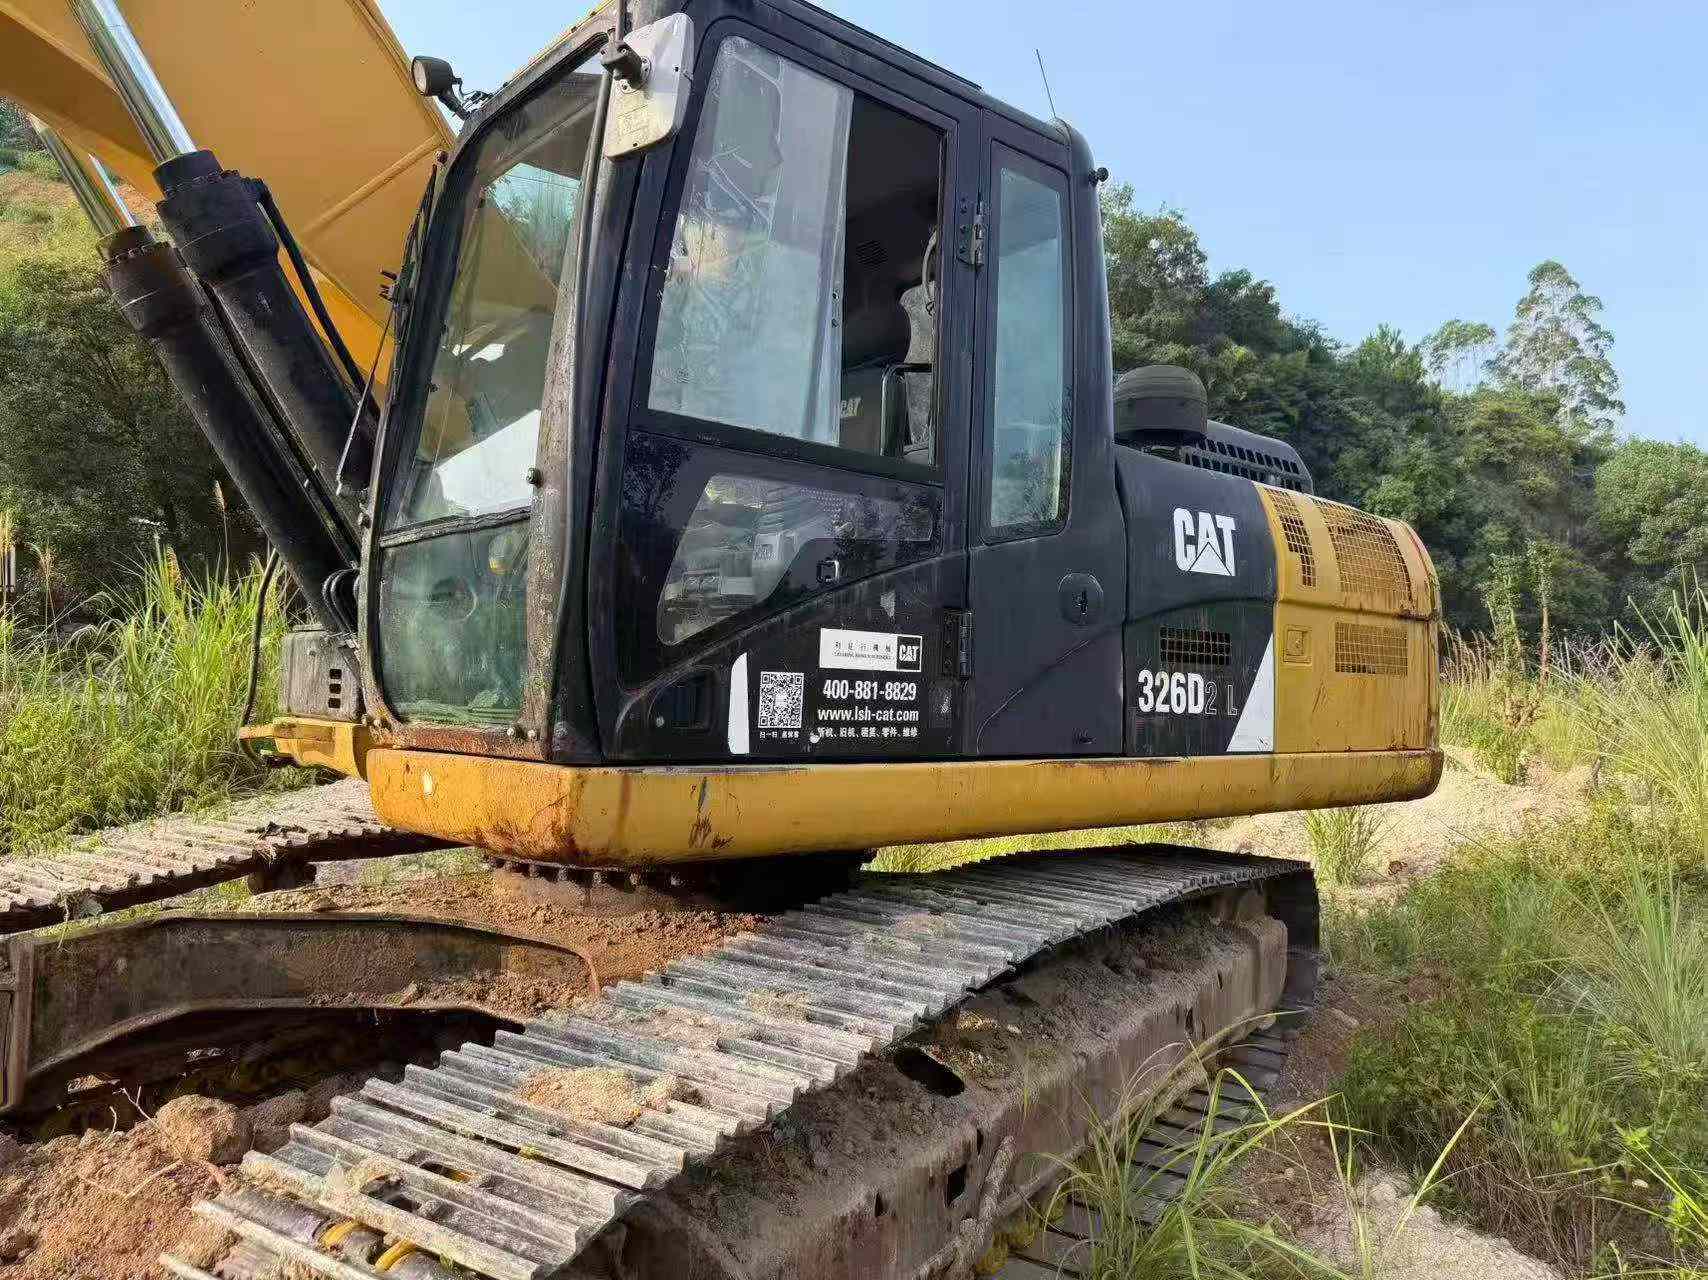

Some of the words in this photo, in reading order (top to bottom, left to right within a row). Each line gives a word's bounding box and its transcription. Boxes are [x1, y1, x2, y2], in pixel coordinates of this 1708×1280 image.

[1174, 507, 1236, 577] CAT
[899, 644, 919, 662] CAT
[823, 679, 917, 700] 400-881-8829
[1227, 684, 1238, 715] L
[817, 705, 919, 721] www.lsh-cat.com
